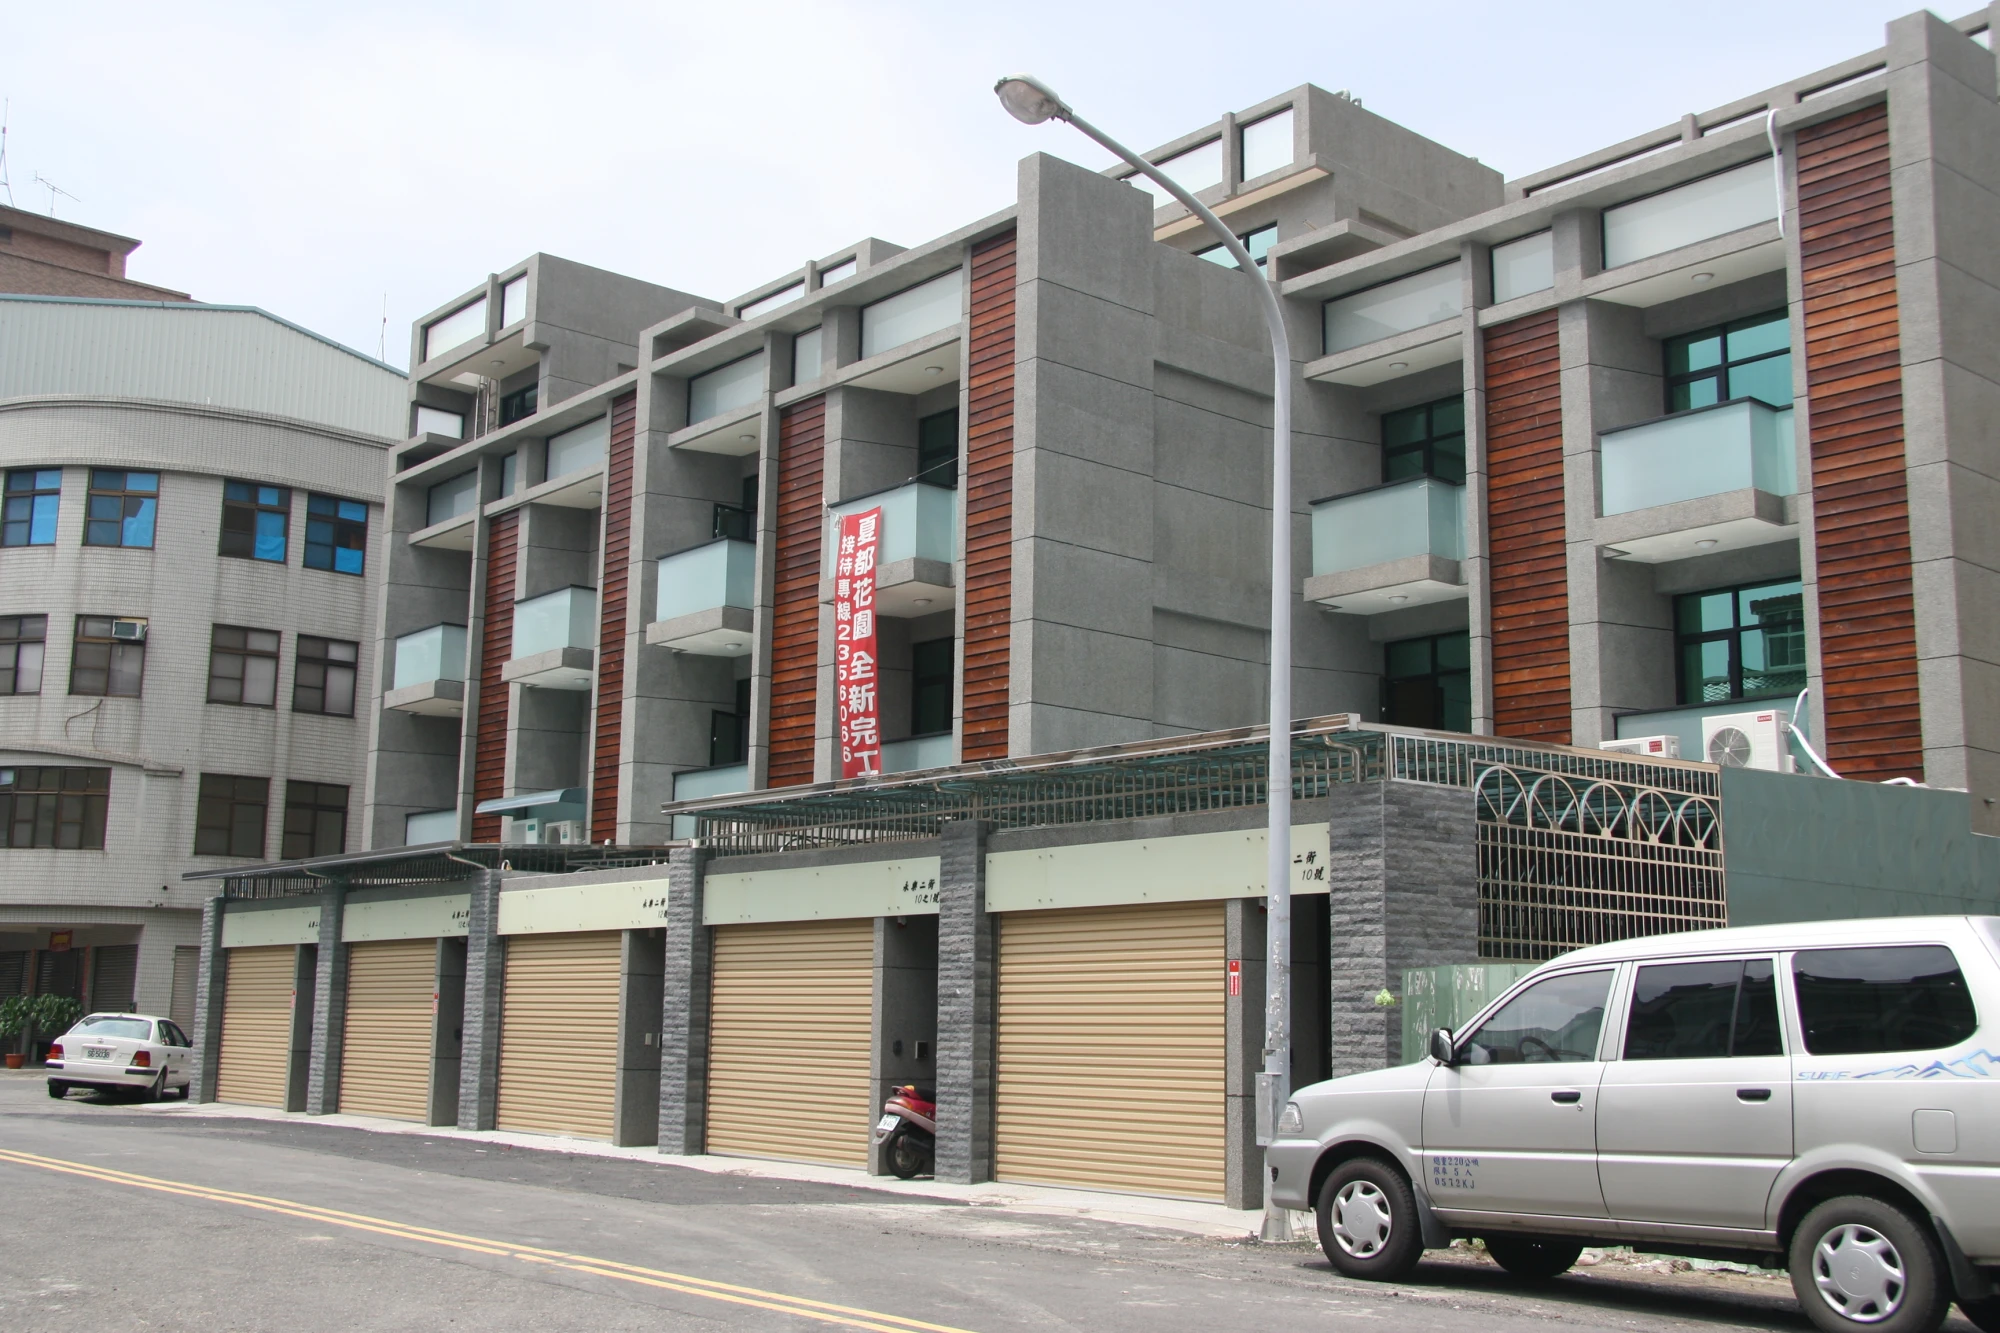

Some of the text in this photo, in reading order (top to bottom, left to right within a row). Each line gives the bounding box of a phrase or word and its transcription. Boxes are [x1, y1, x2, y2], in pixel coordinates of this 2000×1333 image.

[848, 513, 879, 777] 夏都花園 全新完工
[1302, 866, 1325, 881] 10號
[1796, 1070, 1851, 1081] SURF
